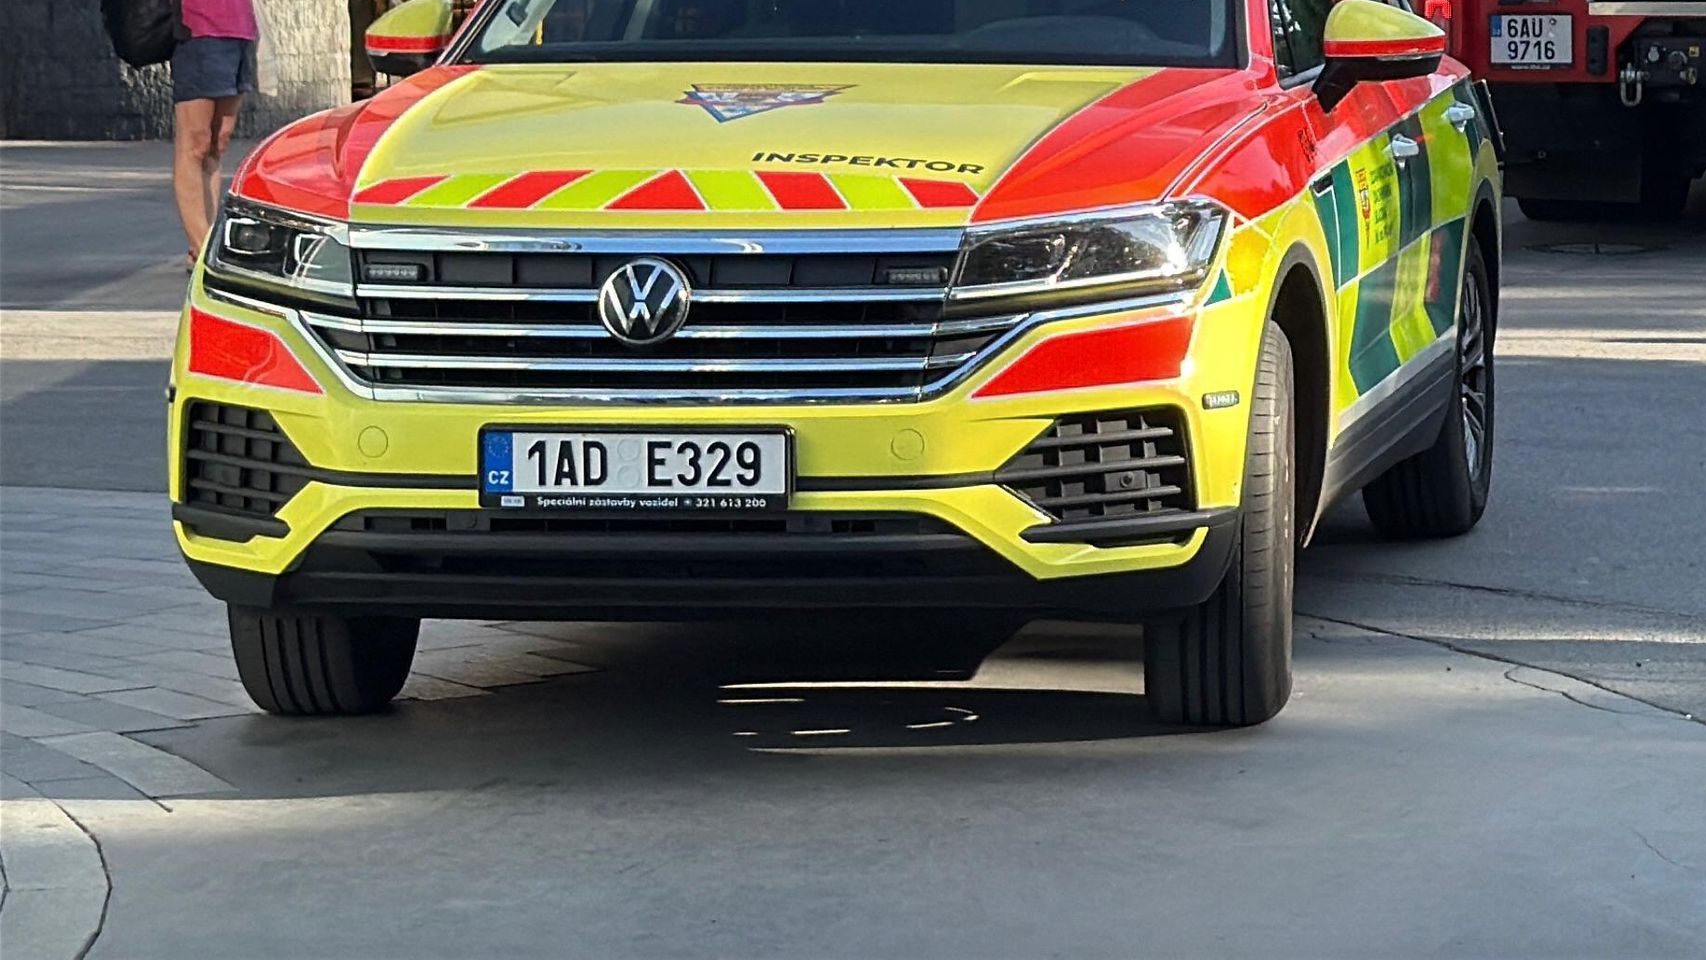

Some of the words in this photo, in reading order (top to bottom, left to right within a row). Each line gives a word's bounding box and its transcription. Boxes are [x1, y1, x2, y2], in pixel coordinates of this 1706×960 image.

[1507, 18, 1543, 38] 6AU
[1508, 40, 1556, 61] 9716
[751, 152, 985, 175] INSPEKTOR
[527, 440, 608, 487] 1AD
[646, 440, 762, 488] E329
[487, 470, 510, 485] CZ
